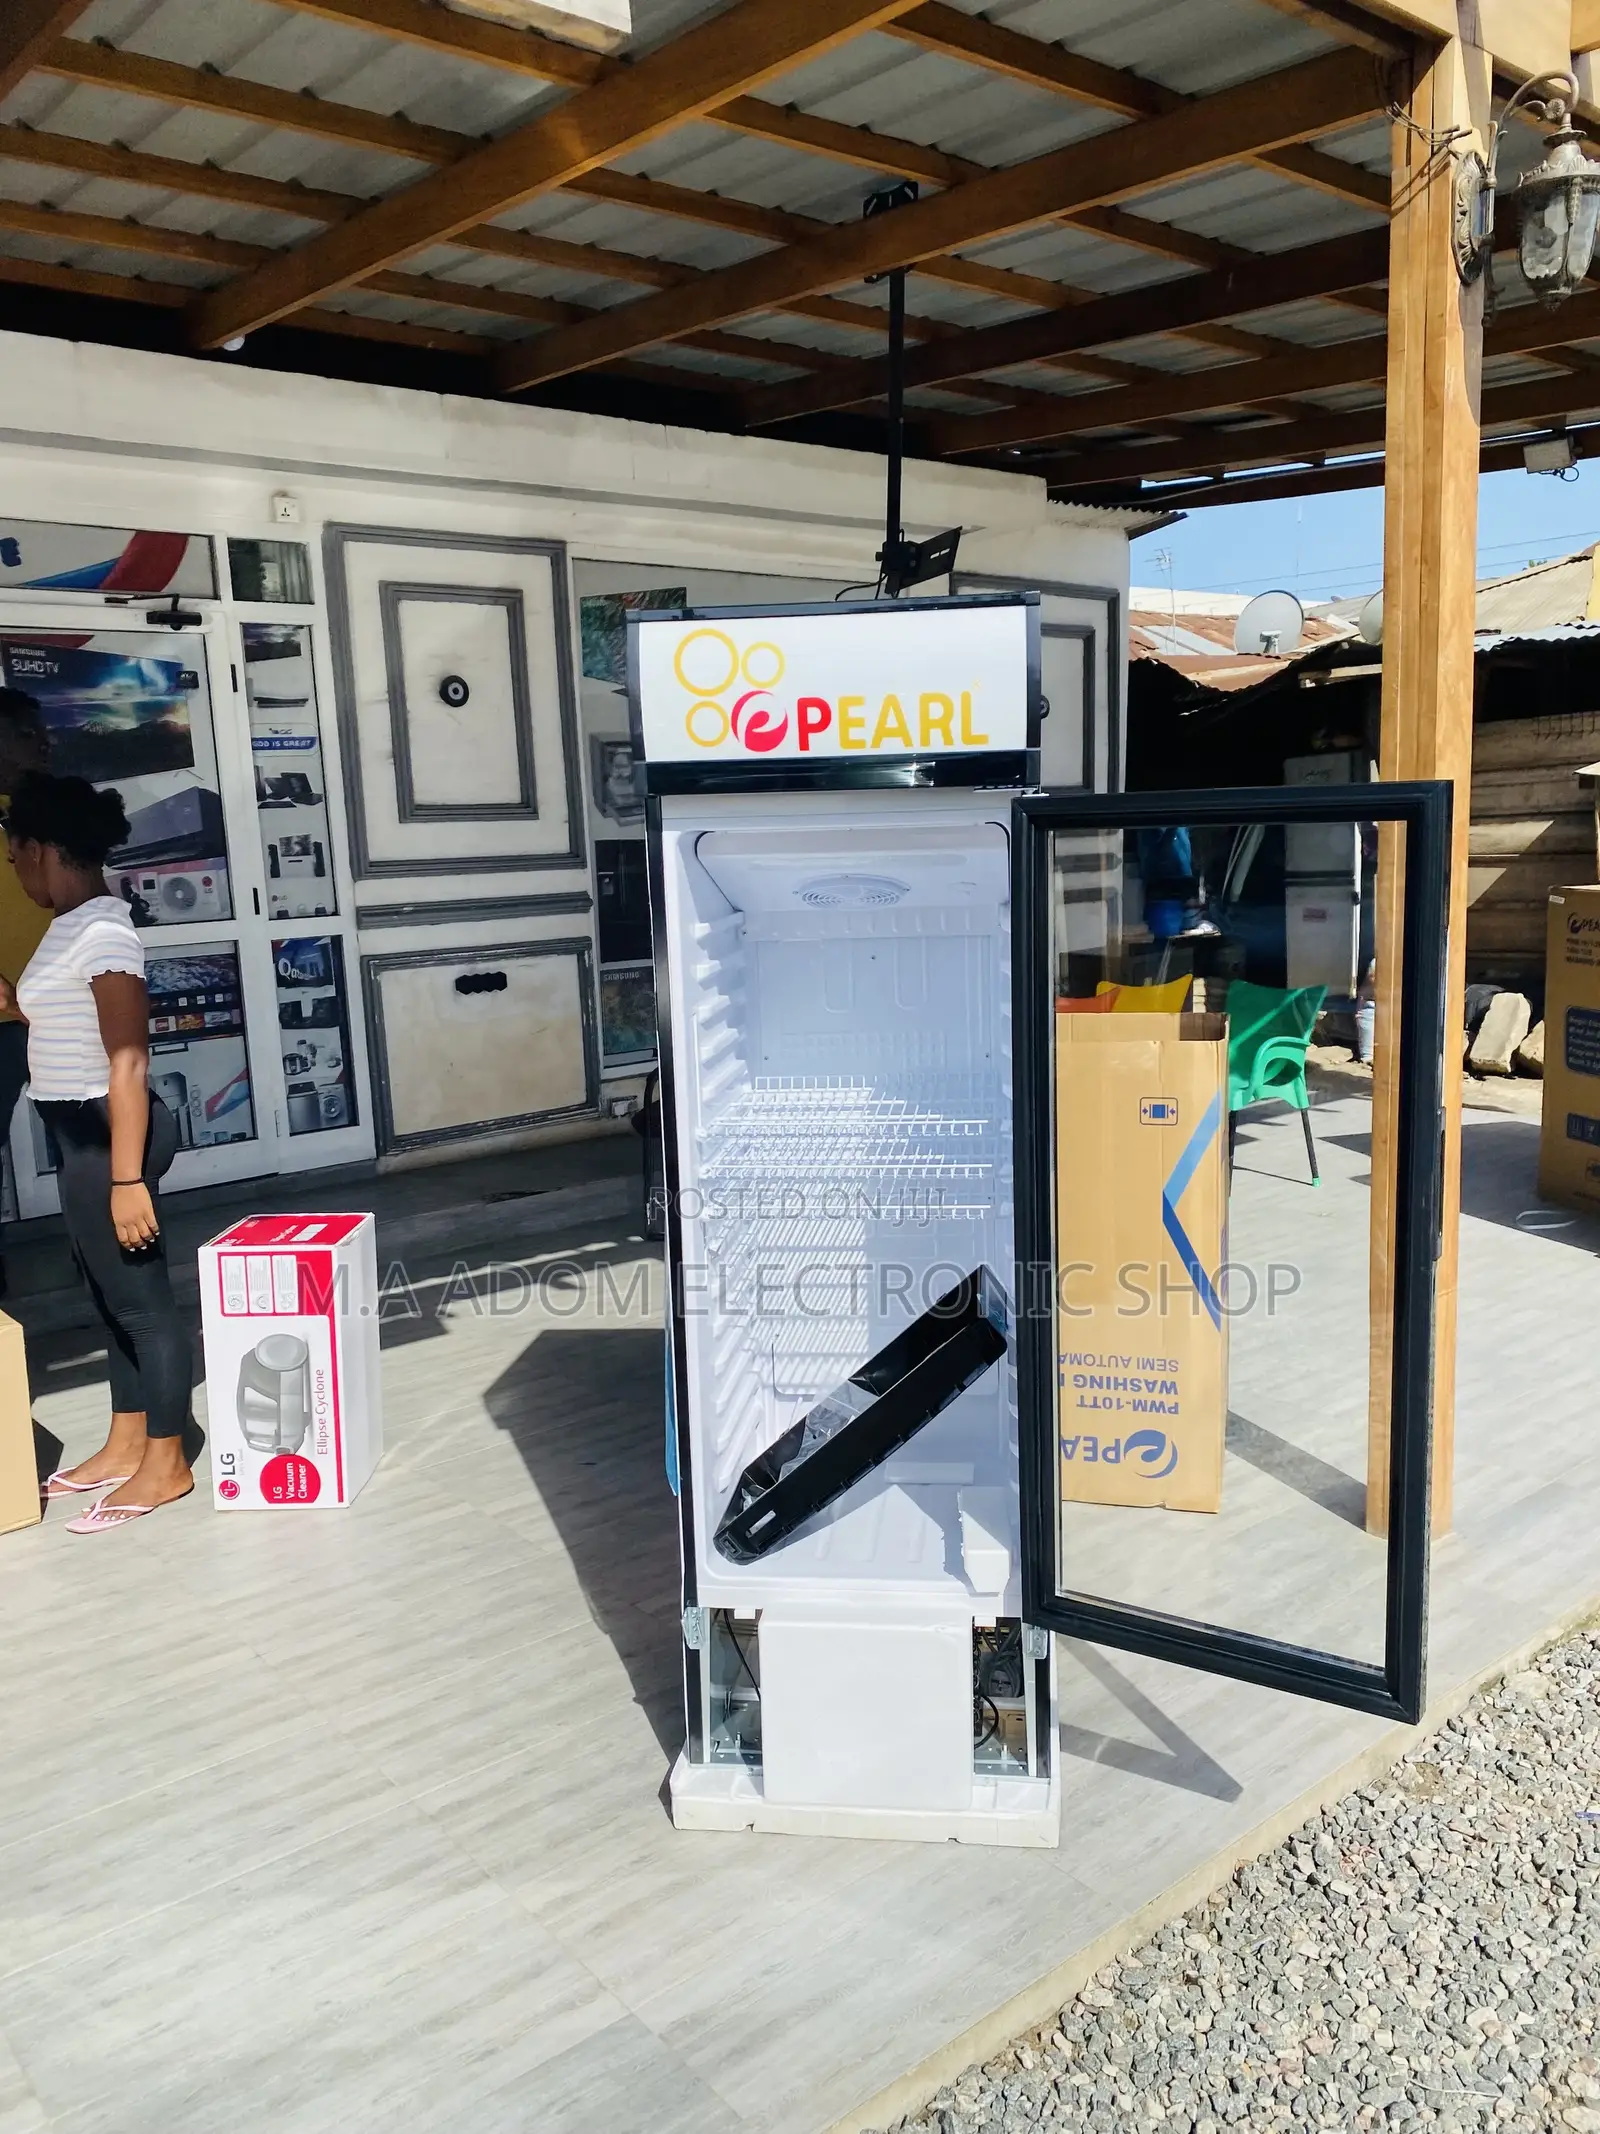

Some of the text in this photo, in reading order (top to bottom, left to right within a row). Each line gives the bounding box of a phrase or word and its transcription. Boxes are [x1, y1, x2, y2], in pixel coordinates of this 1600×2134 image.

[797, 691, 989, 752] PEARL
[1136, 1357, 1179, 1373] SEMI
[1073, 1374, 1178, 1395] WASHING
[313, 1369, 330, 1455] Ellipse Cyclone
[1076, 1395, 1179, 1415] PWM-10TT
[220, 1453, 236, 1475] LG
[286, 1462, 295, 1499] Vacuum
[298, 1463, 312, 1499] Cleaner
[273, 1486, 283, 1499] LG
